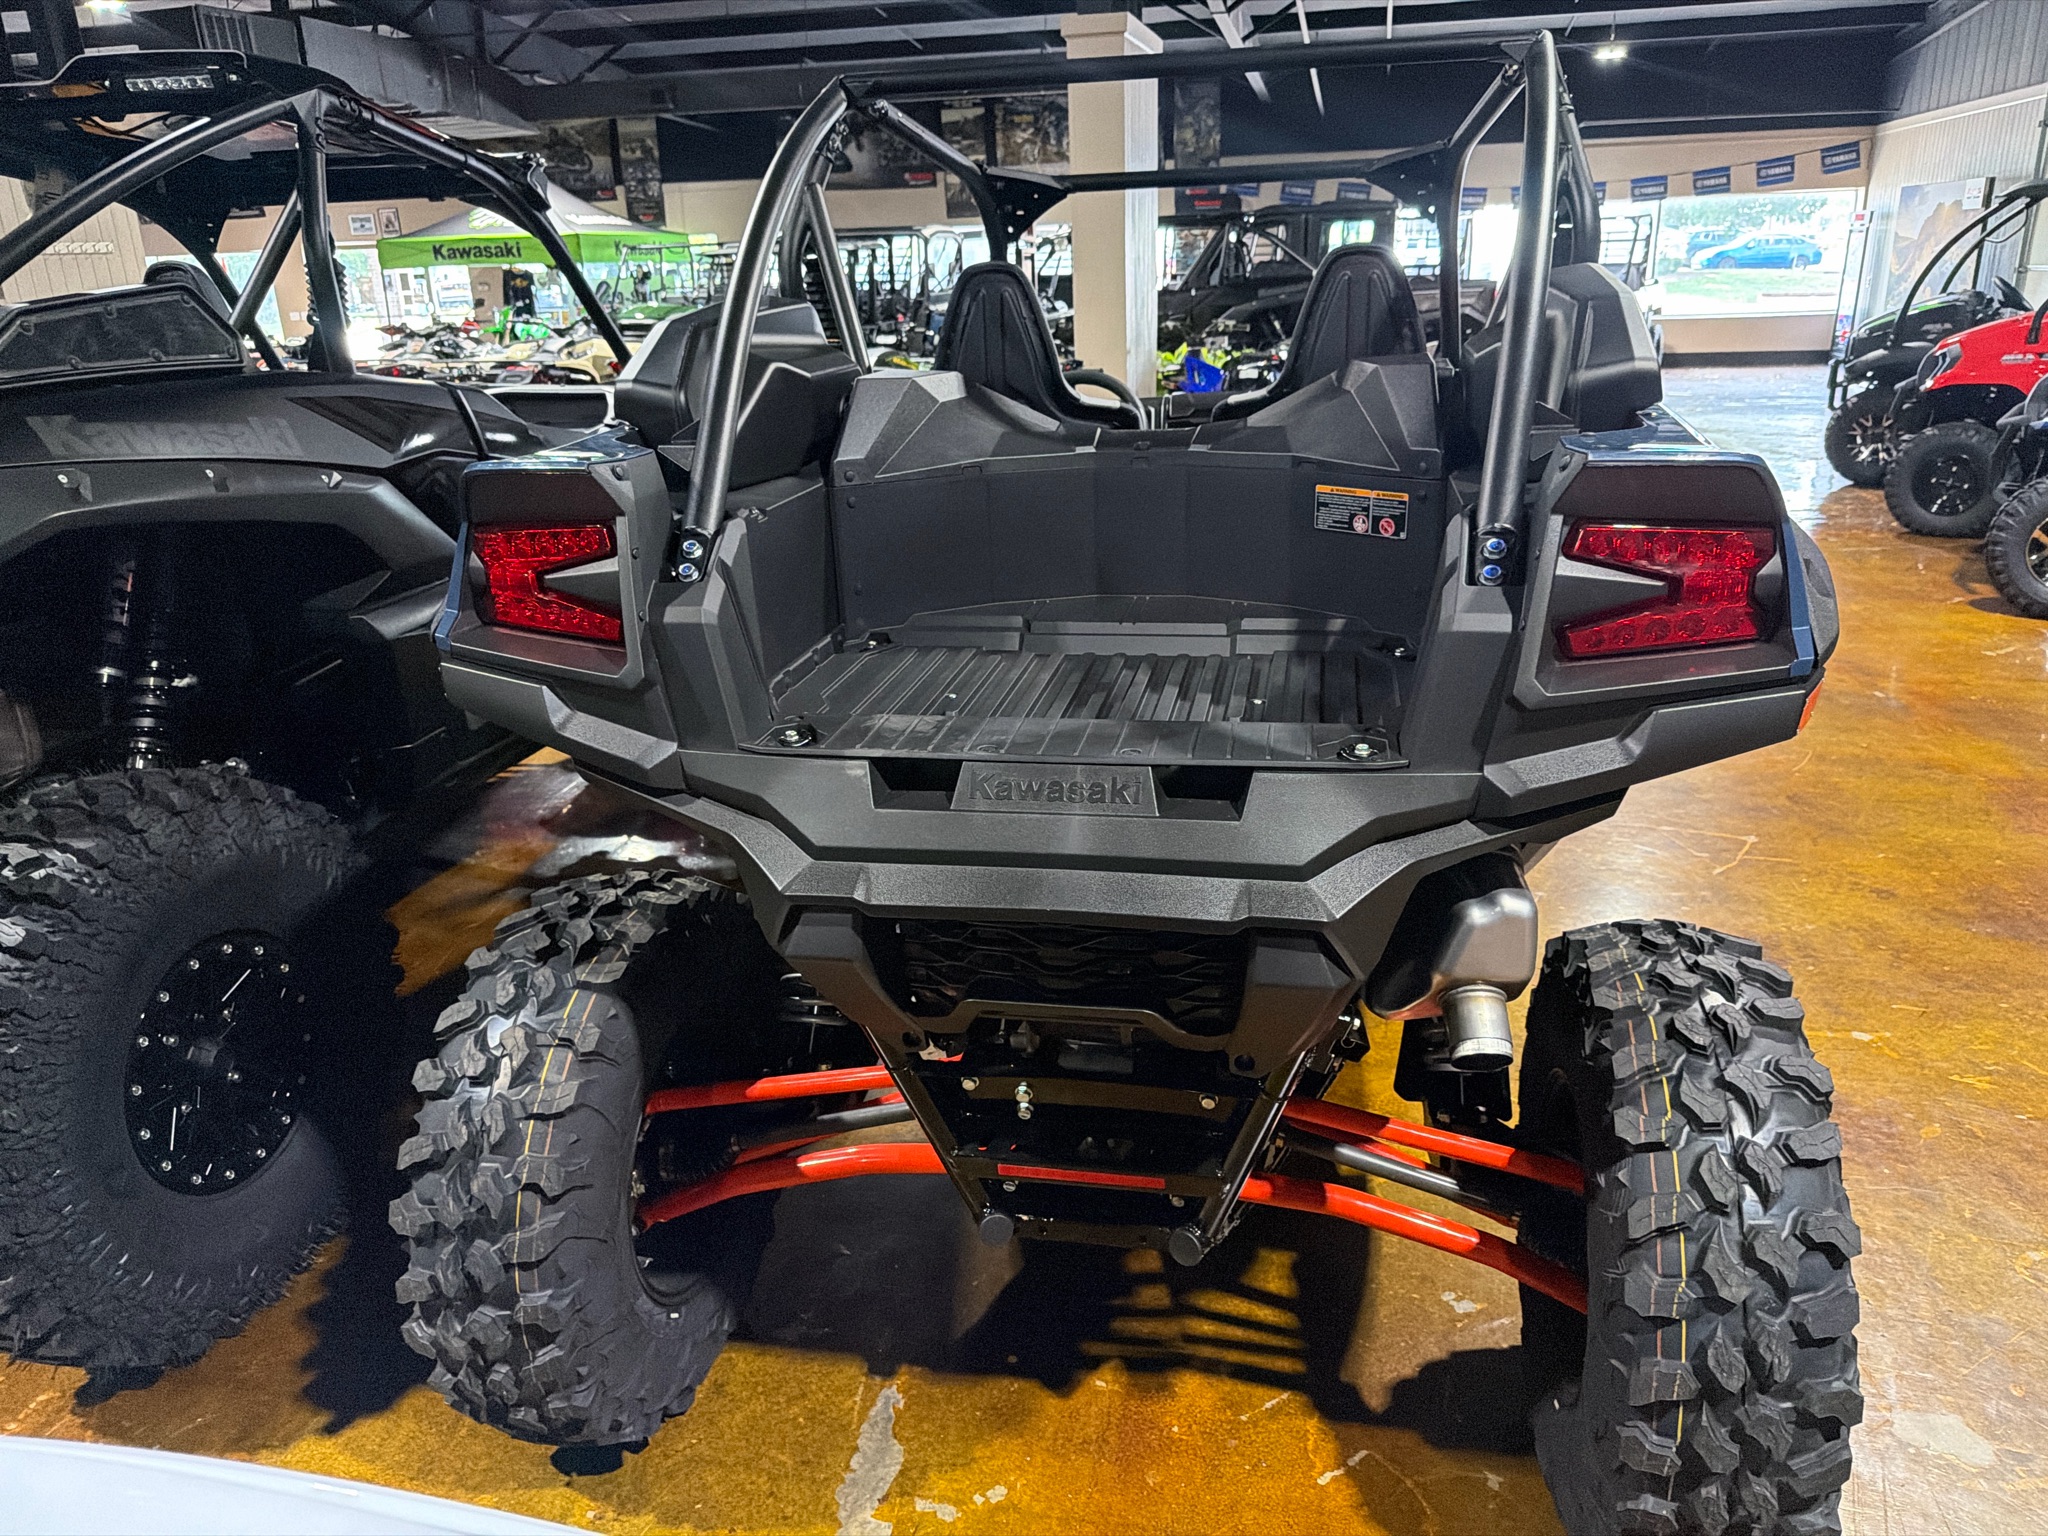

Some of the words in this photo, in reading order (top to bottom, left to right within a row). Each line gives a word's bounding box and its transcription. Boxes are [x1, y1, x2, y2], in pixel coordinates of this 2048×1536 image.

[432, 241, 522, 260] Kawasaki
[25, 414, 305, 457] Kawasaki
[968, 770, 1143, 805] Kawasaki
